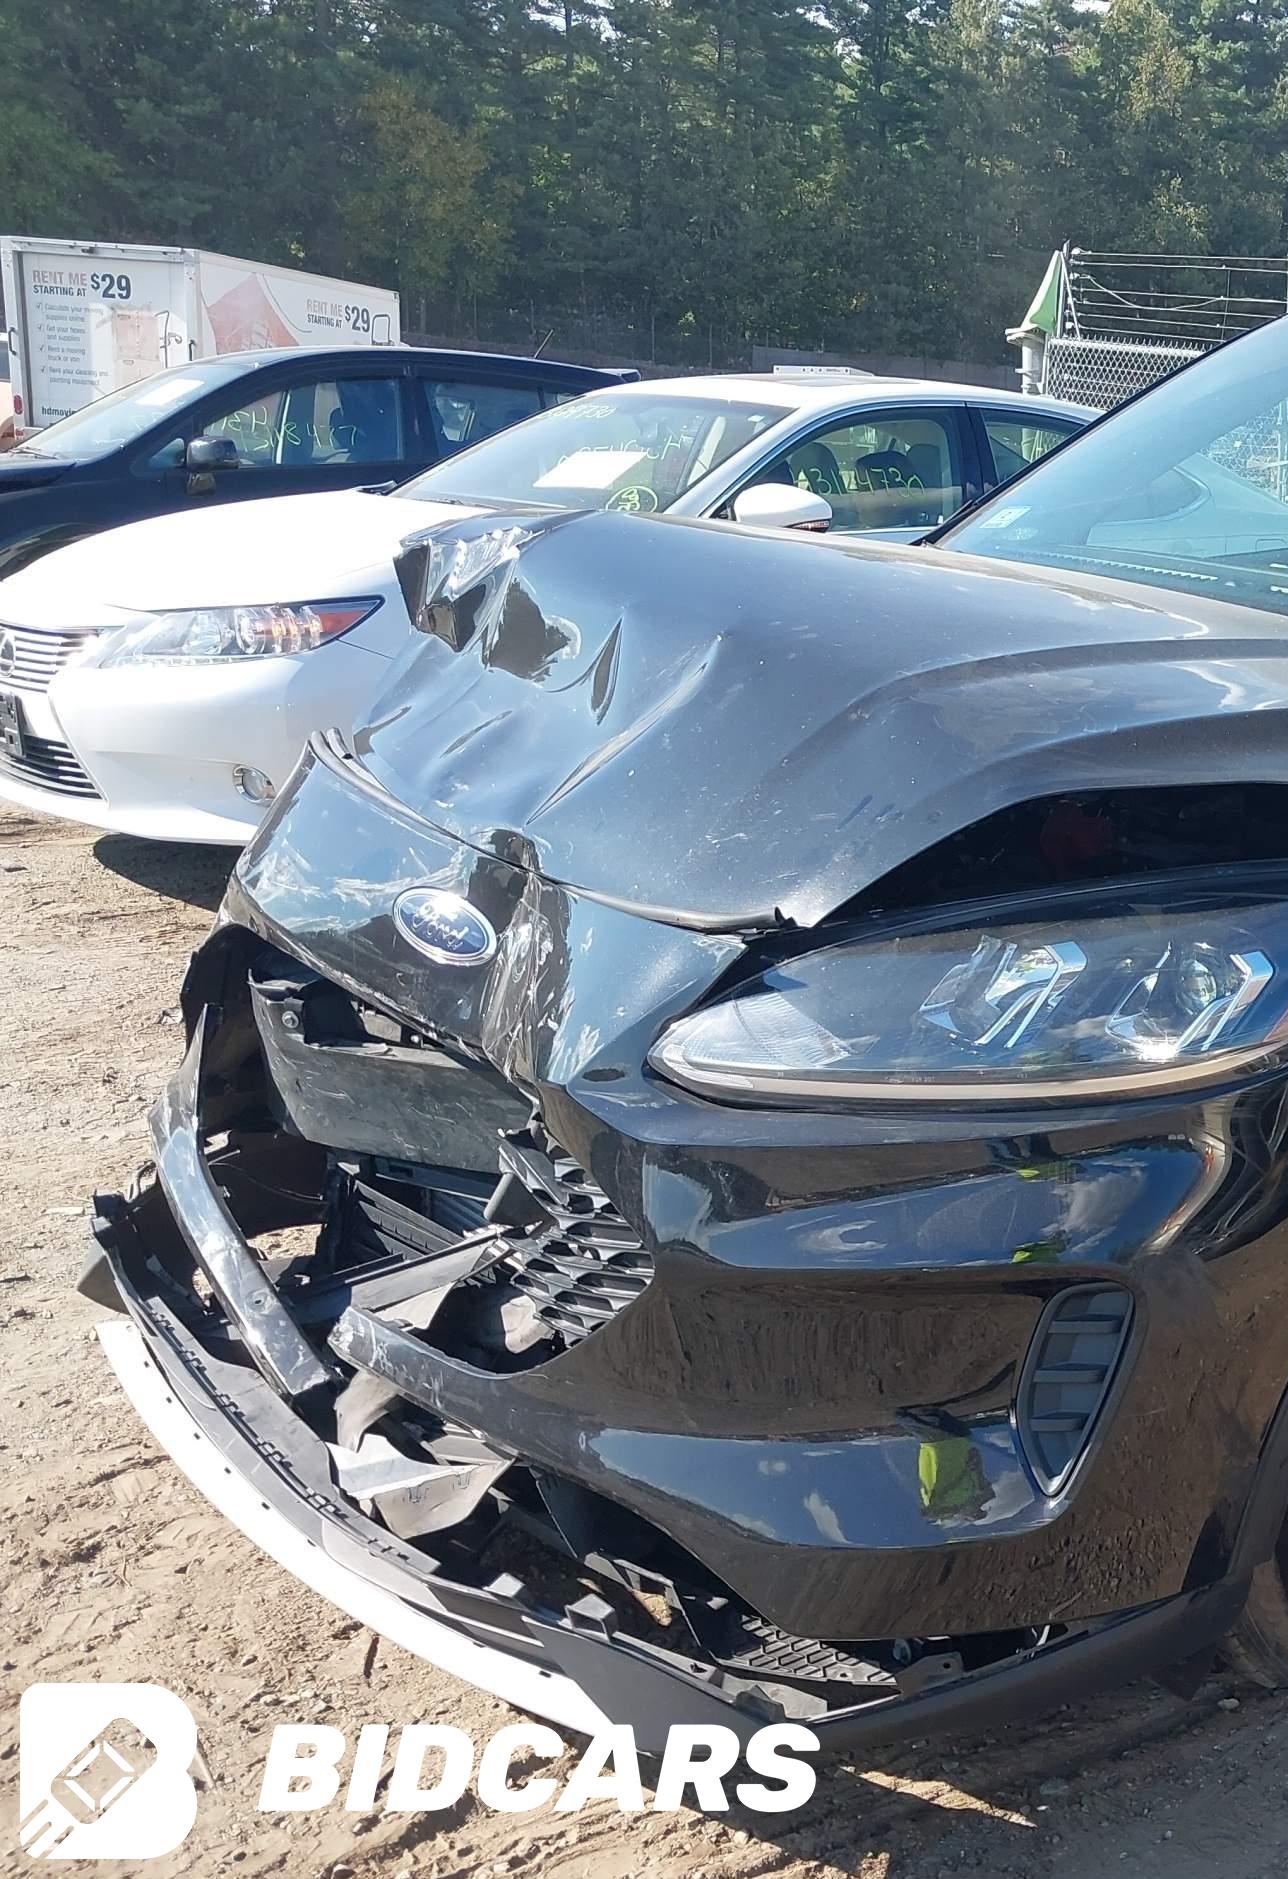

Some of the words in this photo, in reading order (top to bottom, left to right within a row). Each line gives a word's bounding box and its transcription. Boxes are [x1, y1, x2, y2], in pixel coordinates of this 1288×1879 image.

[32, 270, 64, 284] RENT
[68, 272, 88, 287] ME
[90, 272, 132, 300] $29
[33, 284, 74, 297] STARTING
[76, 288, 87, 297] AT
[306, 299, 328, 315] RENT
[330, 303, 343, 317] ME
[307, 313, 335, 328] STARTING
[335, 319, 343, 329] AT
[344, 304, 371, 333] $29
